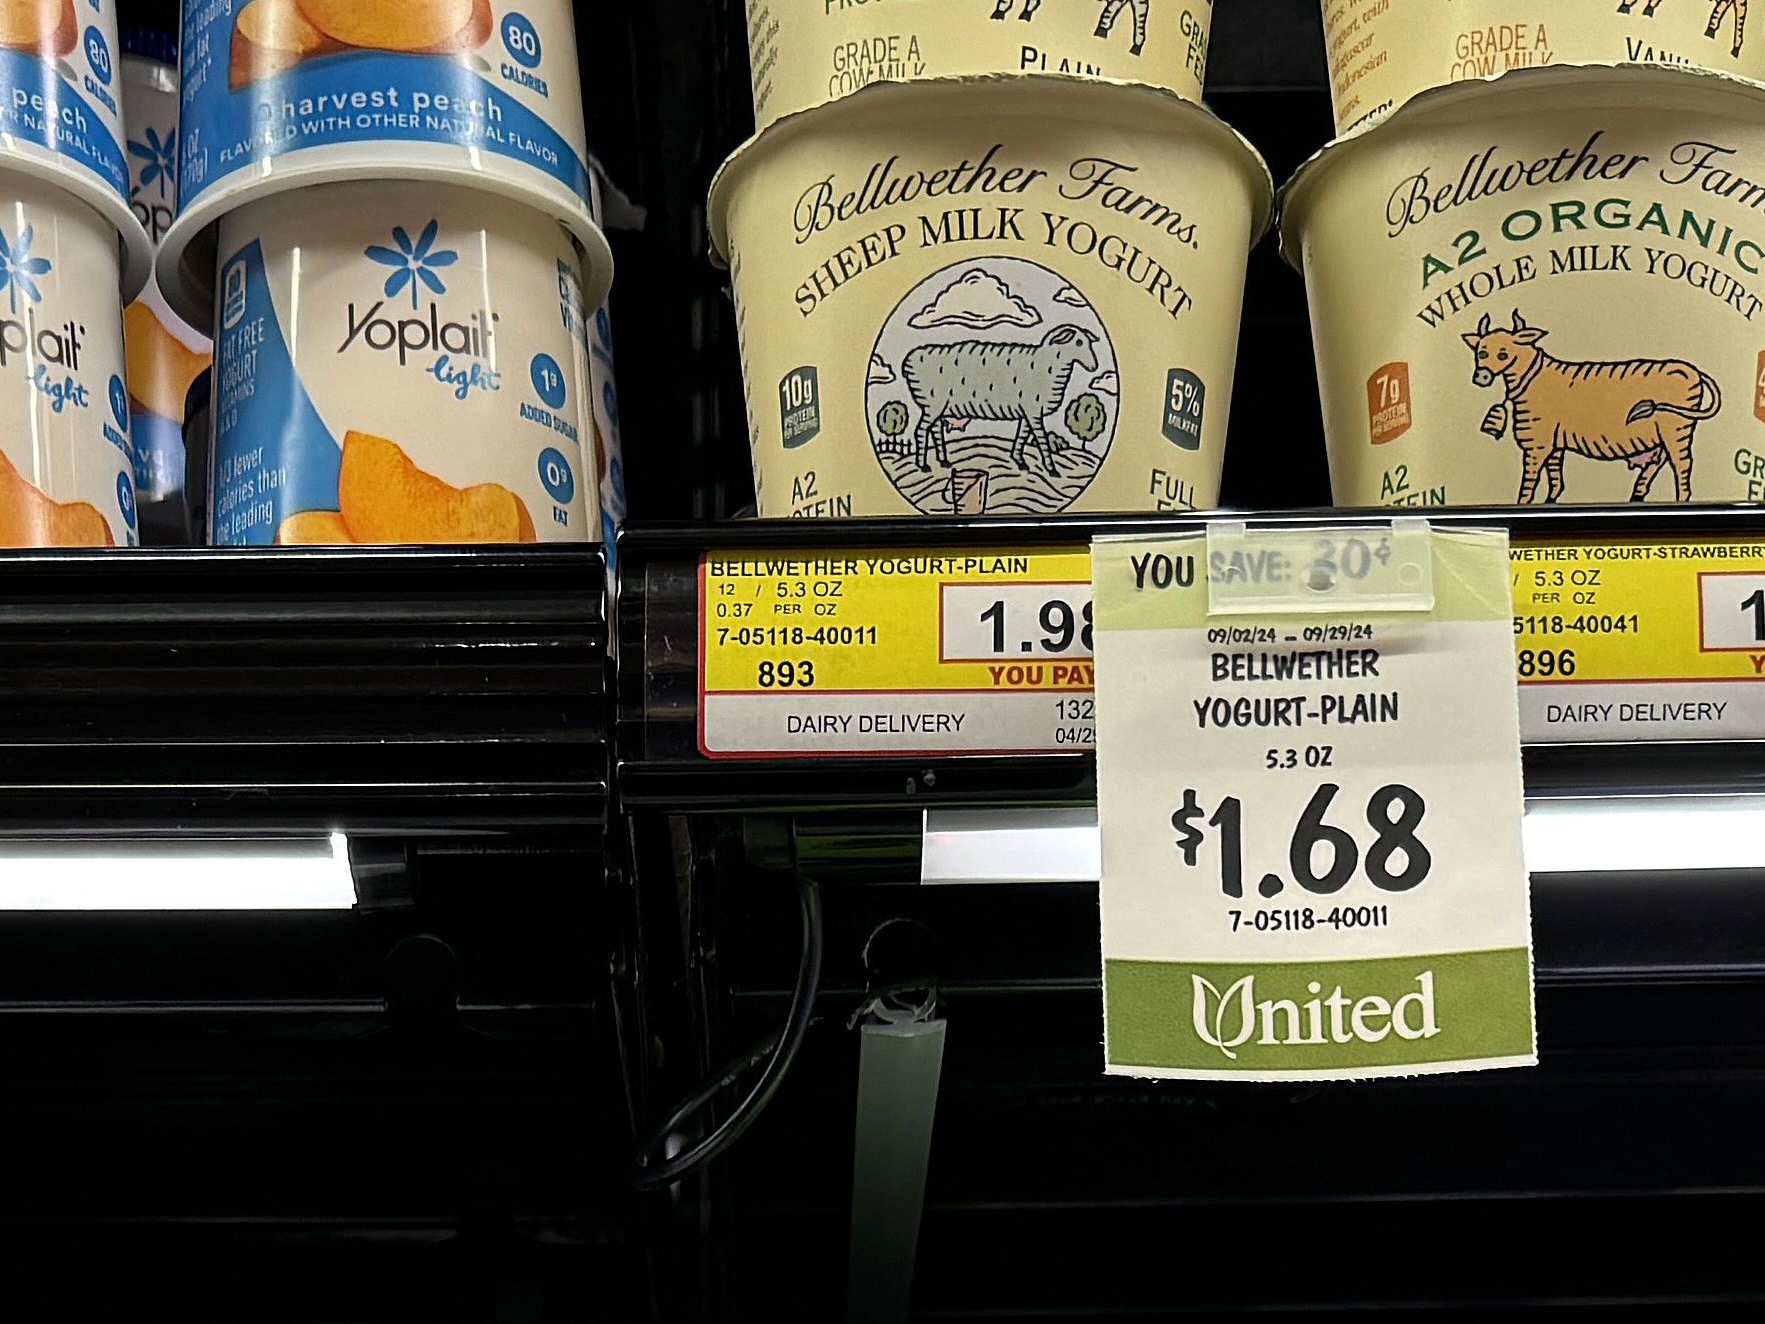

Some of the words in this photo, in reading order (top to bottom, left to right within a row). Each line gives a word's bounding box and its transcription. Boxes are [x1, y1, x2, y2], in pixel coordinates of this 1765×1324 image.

[793, 143, 1047, 244] Bellwether
[794, 225, 908, 318] SHEEP
[919, 207, 1025, 247] MILK
[1041, 212, 1192, 320] YOGURT
[1421, 230, 1487, 290] A2
[1416, 254, 1536, 330] WHOLE
[1550, 244, 1631, 275] MILK
[1644, 249, 1763, 323] YOGURT
[710, 559, 858, 577] BELLWETHER
[865, 557, 1027, 576] YOGURT-PLAIN
[717, 626, 877, 646] 7-05118-40011
[758, 661, 814, 687] 893
[1211, 651, 1378, 682] BELLWETHER
[787, 712, 851, 735] DAIRY
[858, 713, 965, 735] DELIVERY
[1194, 694, 1398, 726] YOGURT-PLAIN
[1266, 748, 1298, 770] 5.3
[1305, 746, 1332, 768] OZ
[1171, 784, 1431, 898] $1.68
[1229, 906, 1388, 931] 7-05118-40011
[1193, 972, 1439, 1058] United
